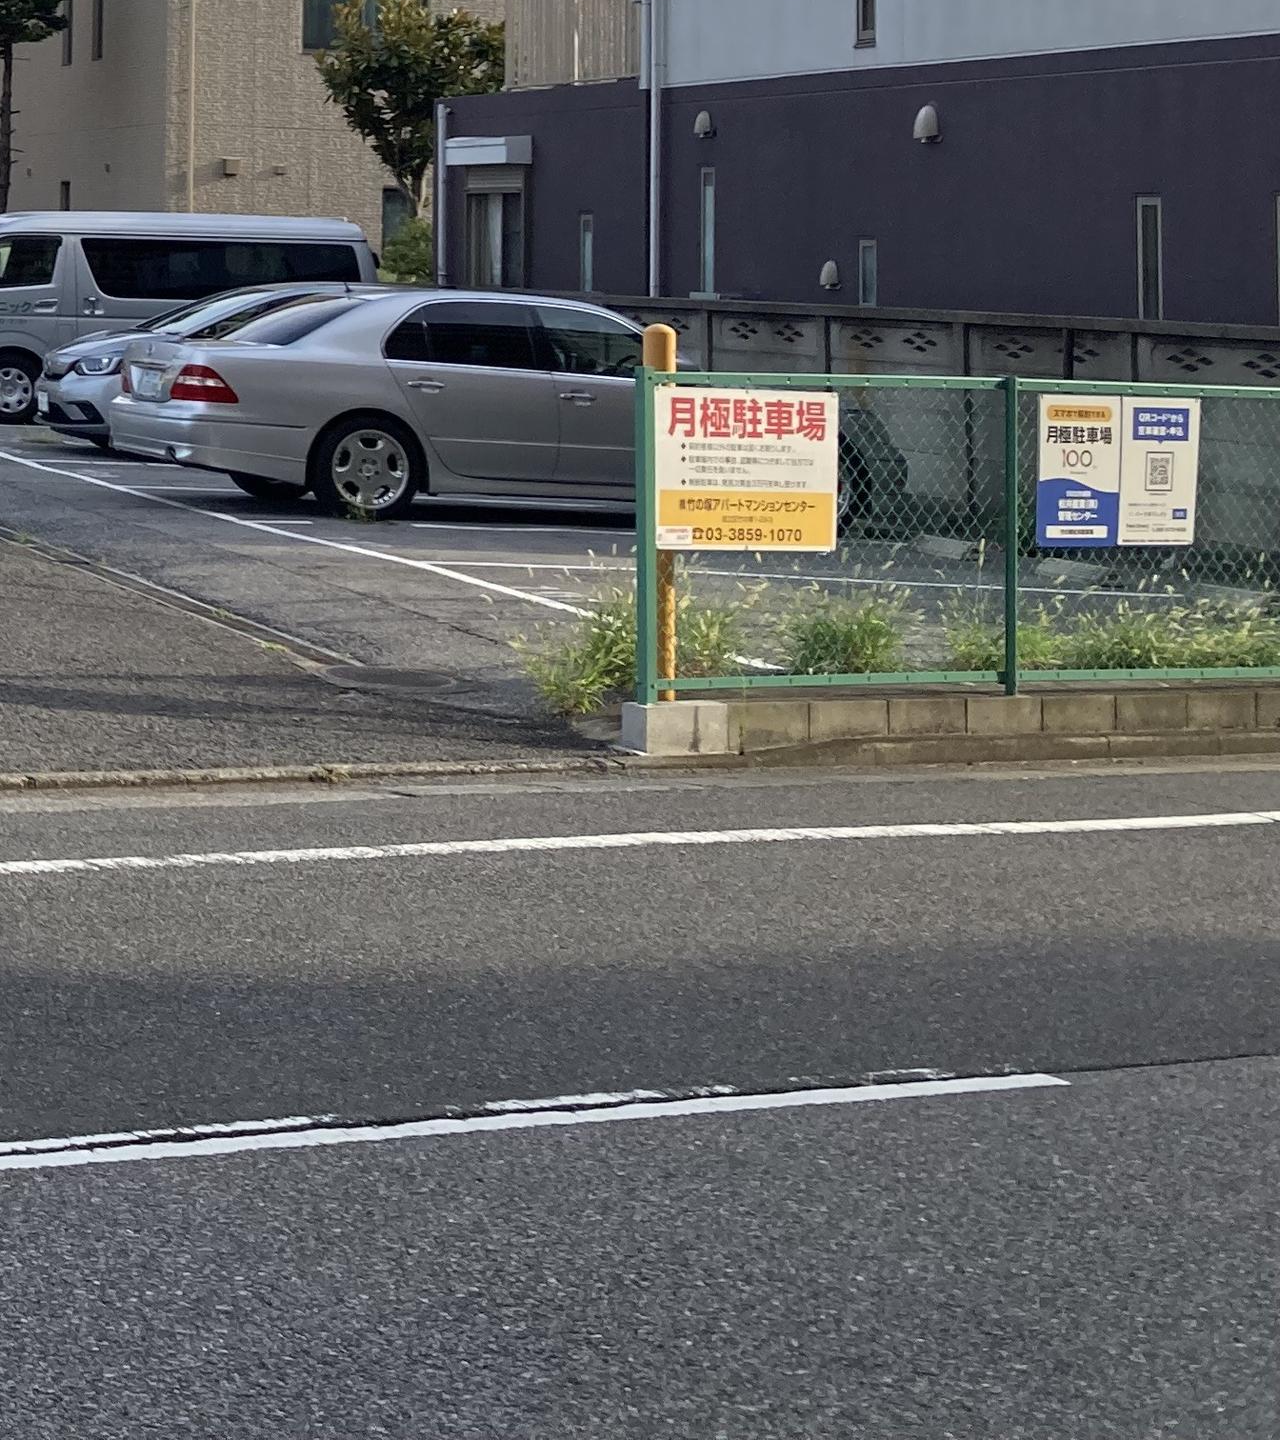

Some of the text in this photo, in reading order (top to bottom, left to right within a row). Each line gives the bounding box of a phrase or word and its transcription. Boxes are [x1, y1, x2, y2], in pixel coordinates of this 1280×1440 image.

[668, 396, 828, 442] 月極駐車場
[1046, 425, 1113, 445] 月極駐車場
[706, 527, 802, 542] 03-3859-1070
